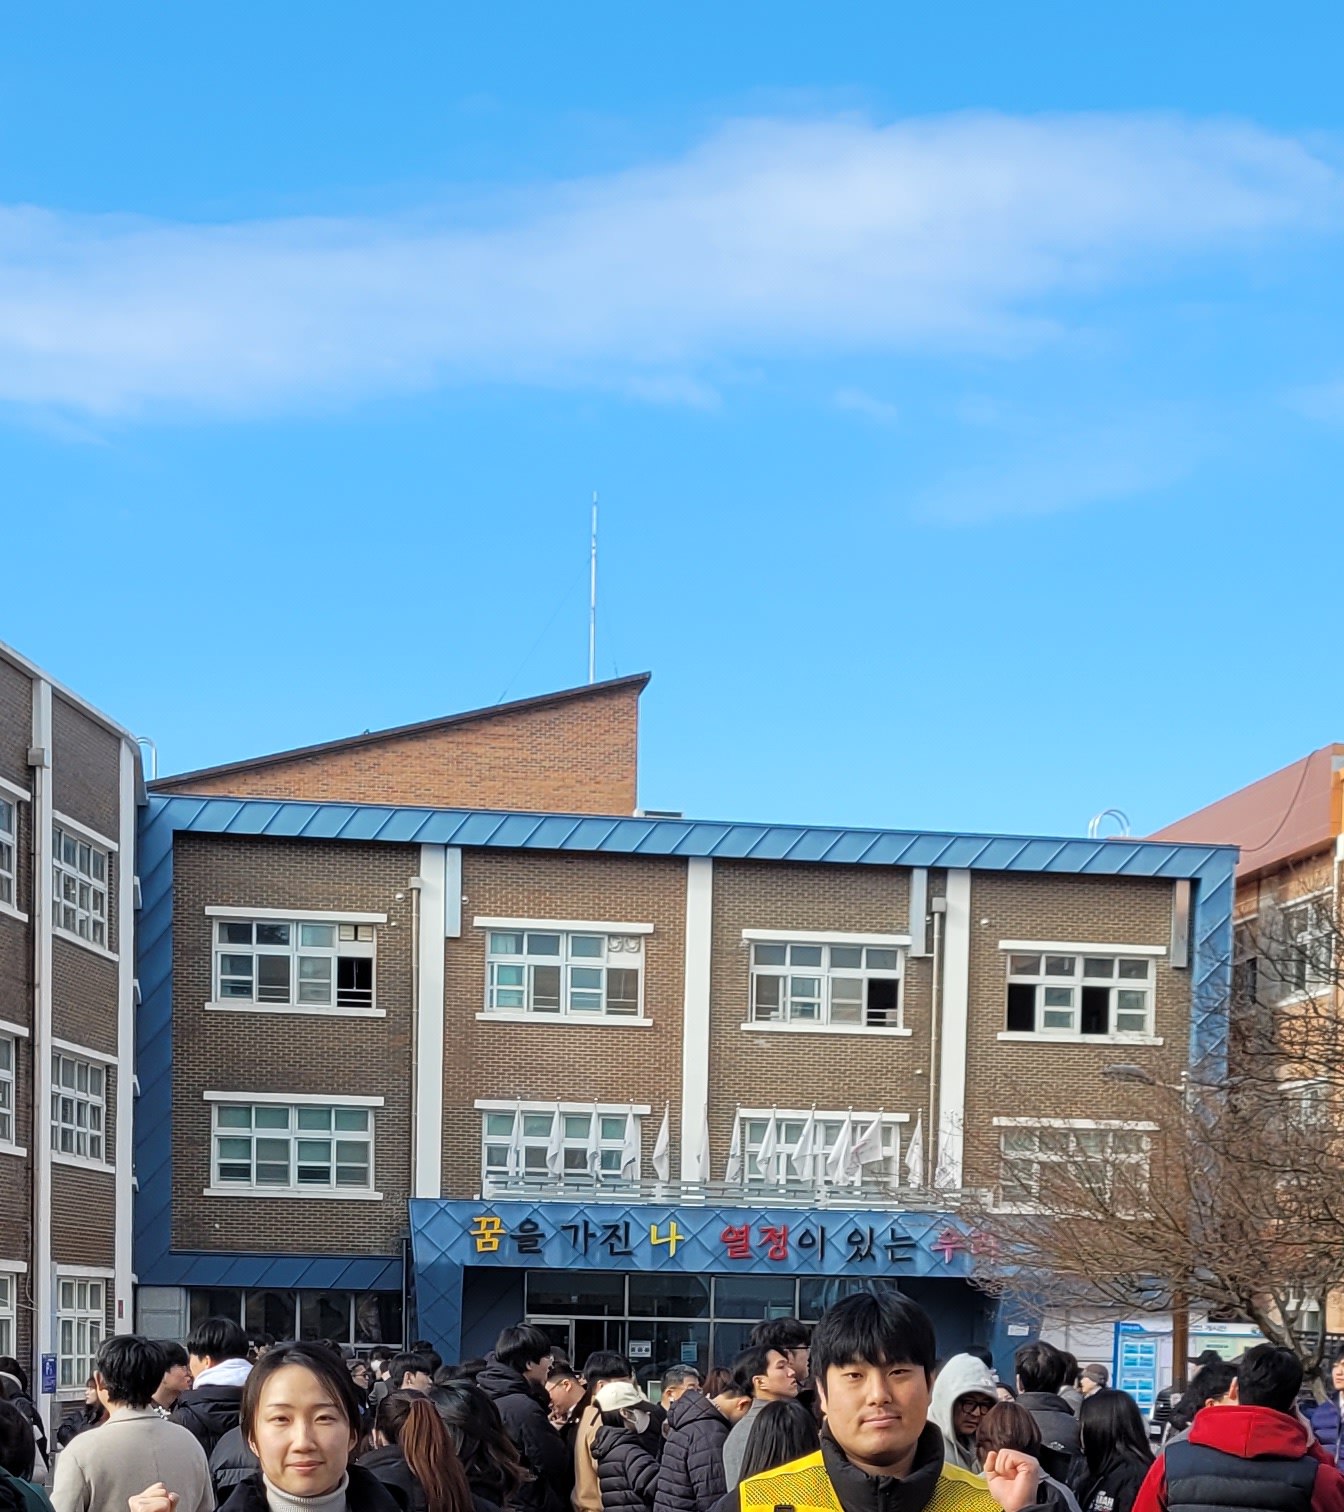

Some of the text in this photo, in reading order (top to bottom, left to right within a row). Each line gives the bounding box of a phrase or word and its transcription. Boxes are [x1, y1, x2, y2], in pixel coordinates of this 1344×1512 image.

[469, 1216, 546, 1255] 꿈을
[561, 1219, 632, 1257] 가진
[649, 1221, 685, 1259] 나
[720, 1223, 825, 1262] 열정이
[846, 1226, 917, 1263] 있는
